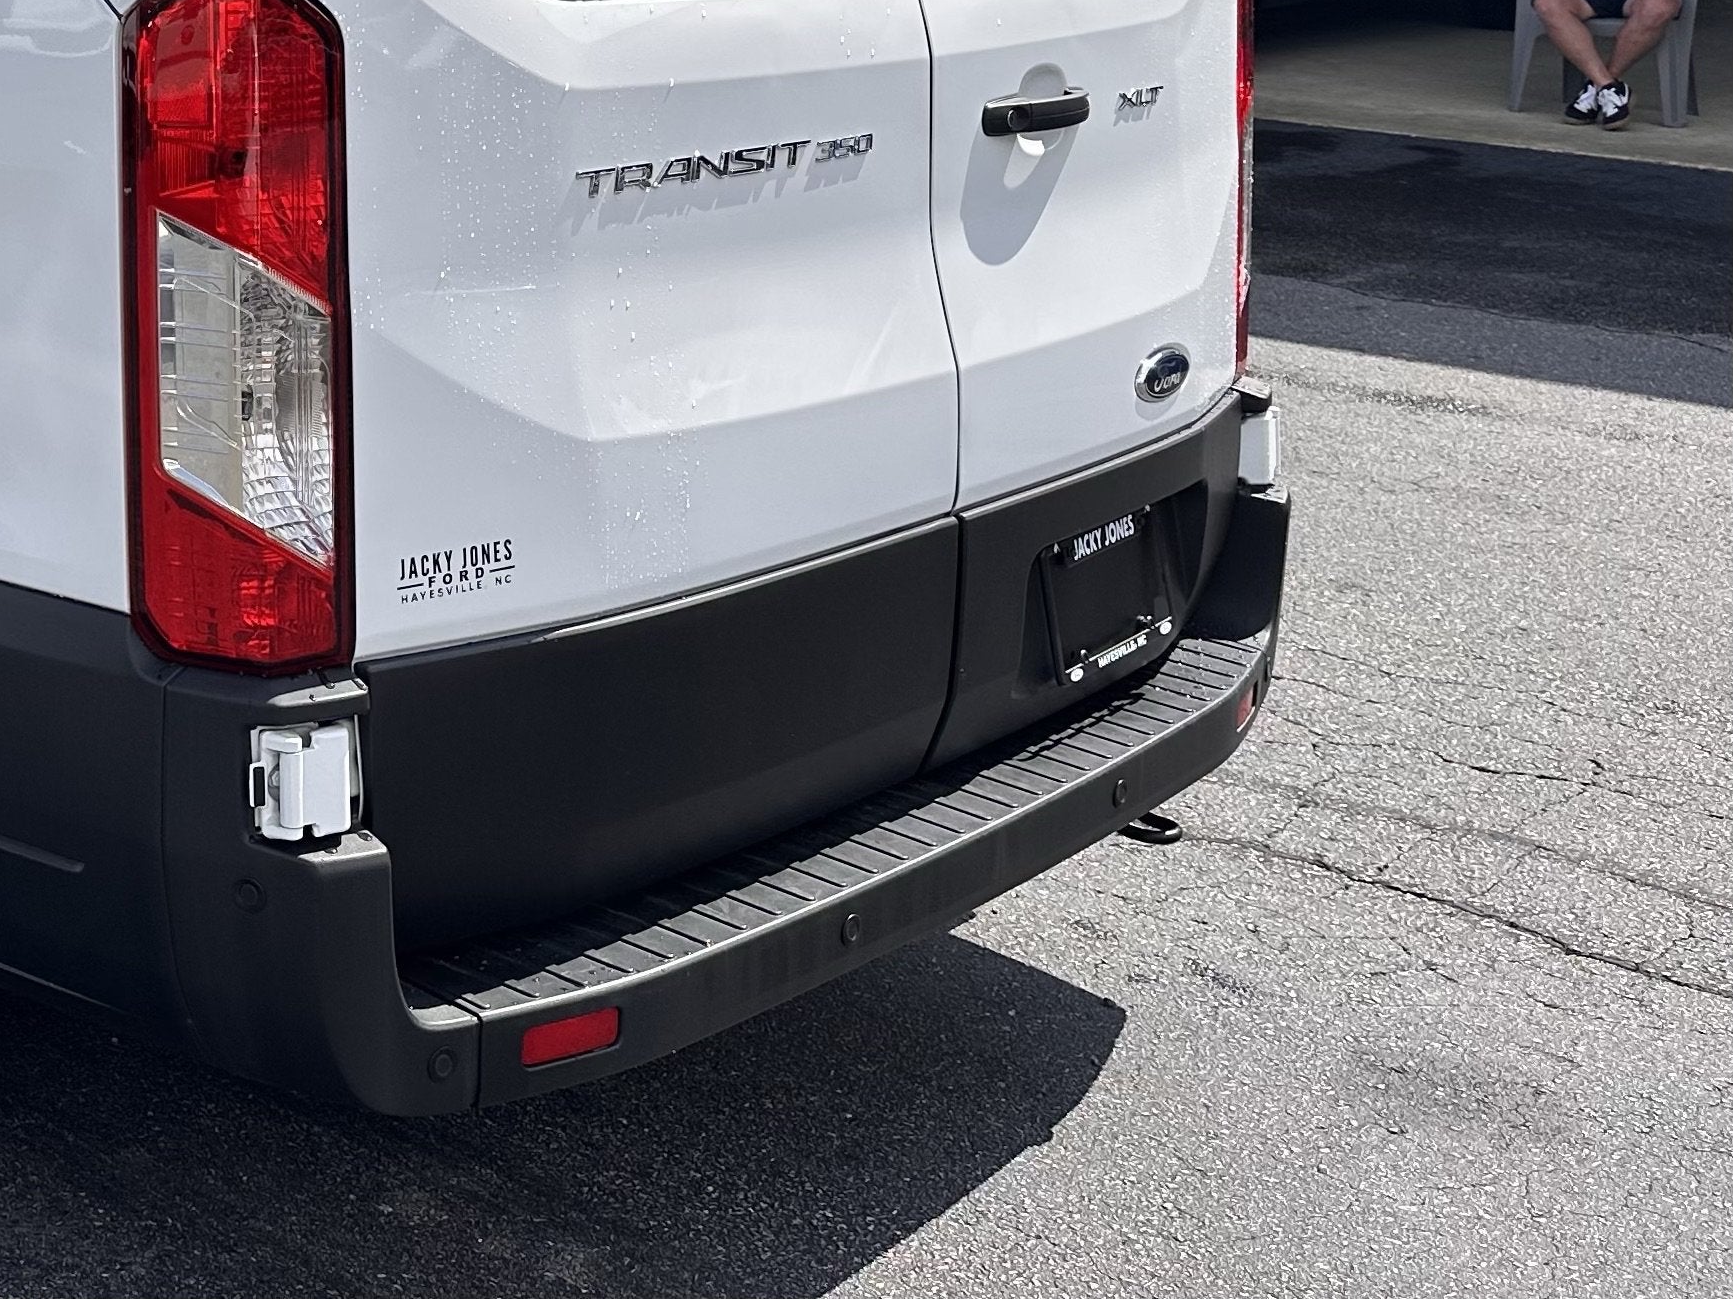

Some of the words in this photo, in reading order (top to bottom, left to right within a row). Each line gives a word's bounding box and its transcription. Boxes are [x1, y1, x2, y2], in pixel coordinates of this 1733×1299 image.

[1118, 85, 1164, 111] XLT
[575, 139, 812, 198] TRANSIT
[815, 133, 873, 162] 350
[1073, 528, 1102, 561] JACKY
[1104, 514, 1135, 546] JONES
[400, 550, 453, 581] JACKY
[462, 539, 512, 569] JONES
[428, 567, 485, 588] FORD
[495, 574, 512, 586] NC
